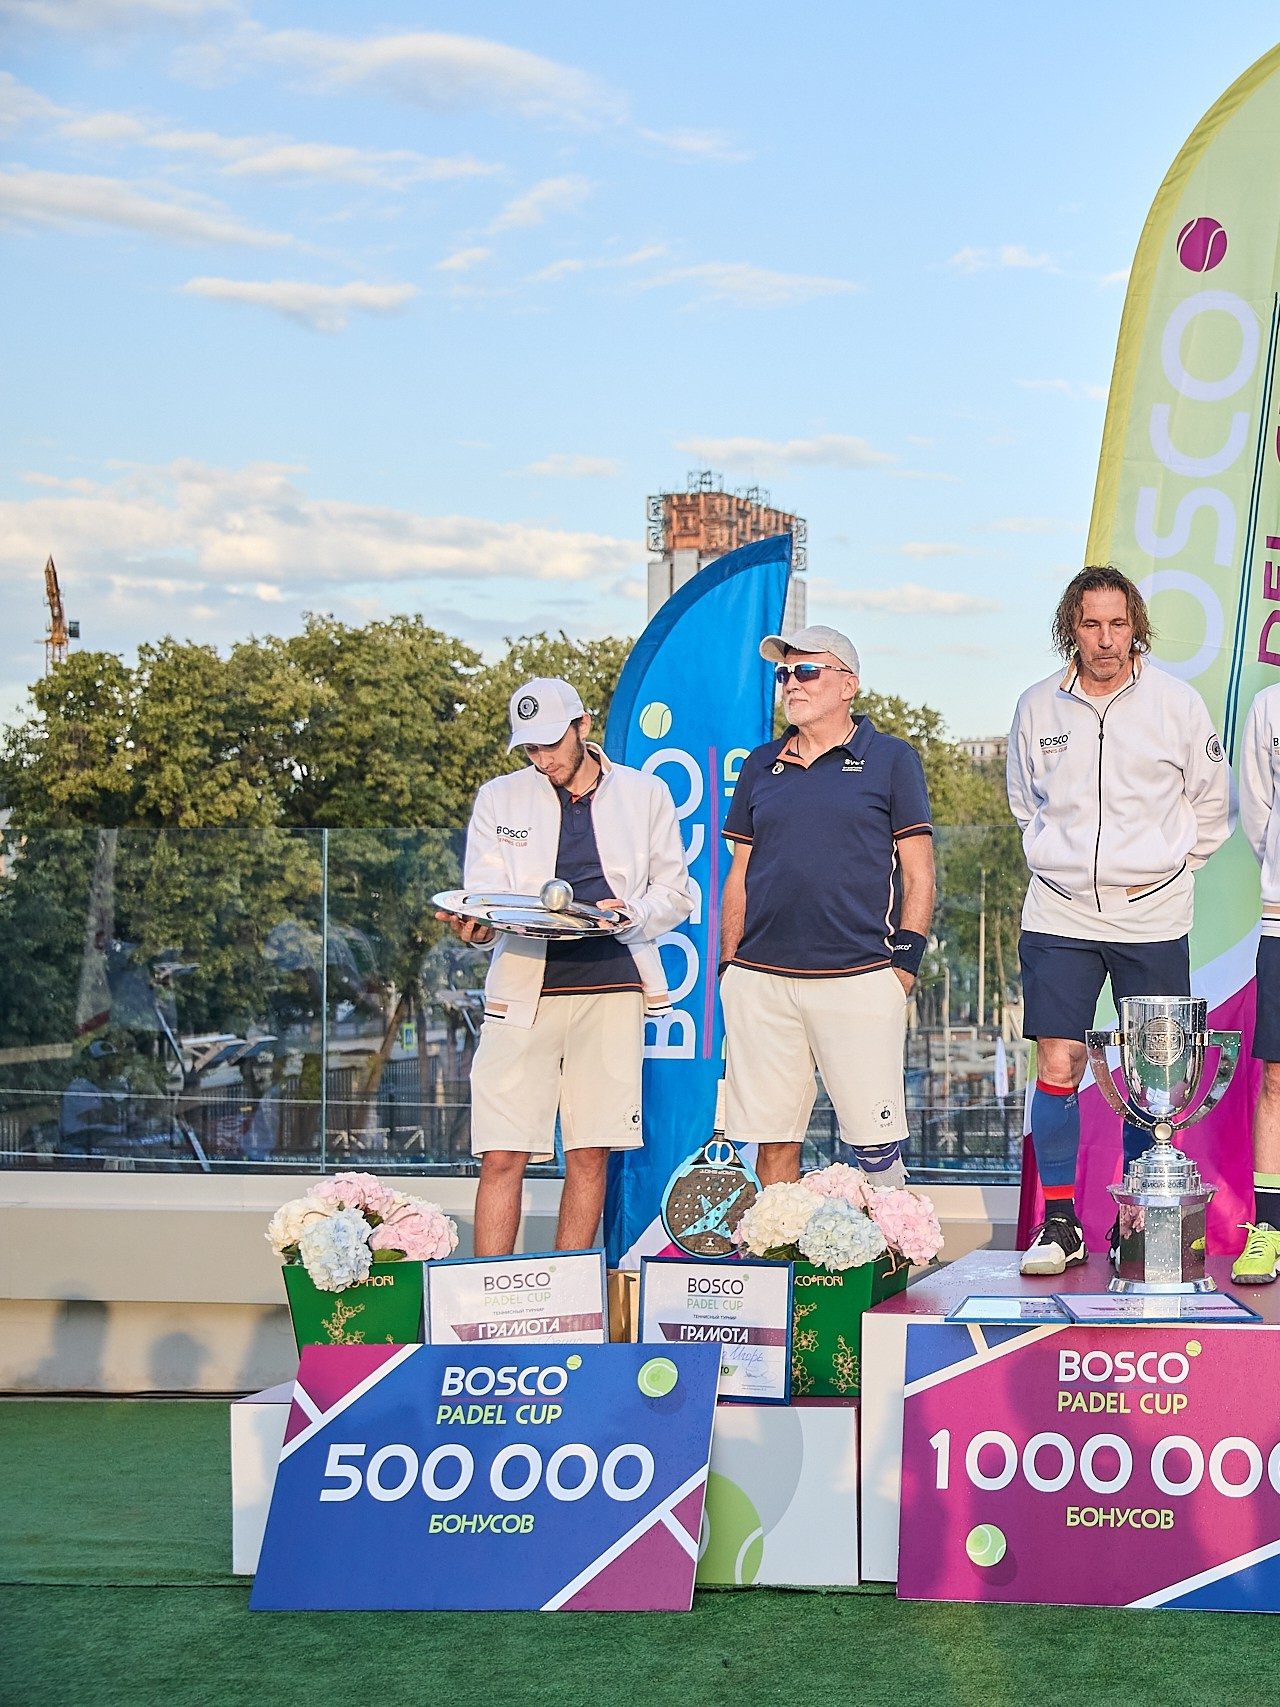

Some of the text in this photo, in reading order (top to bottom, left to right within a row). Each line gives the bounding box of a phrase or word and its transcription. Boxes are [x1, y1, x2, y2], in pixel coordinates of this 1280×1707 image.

[1134, 289, 1260, 681] OSCO
[1040, 734, 1068, 747] BOSCO
[496, 825, 529, 839] BOSCO
[483, 1271, 551, 1292] BOSCO
[687, 1277, 744, 1295] BOSCO
[484, 1291, 551, 1307] PADEL CUP
[686, 1298, 744, 1311] PADEL CUP
[478, 1317, 560, 1339] ГРАМОТА
[680, 1325, 749, 1343] ГРАМОТА
[1057, 1350, 1190, 1384] BOSCO
[441, 1365, 568, 1397] BOSCO
[1057, 1391, 1189, 1415] PADEL CUP
[436, 1403, 564, 1426] PADEL CUP
[319, 1442, 656, 1503] 500 000
[428, 1513, 535, 1535] БОНУСОВ
[1066, 1505, 1175, 1531] БОНУСОВ
